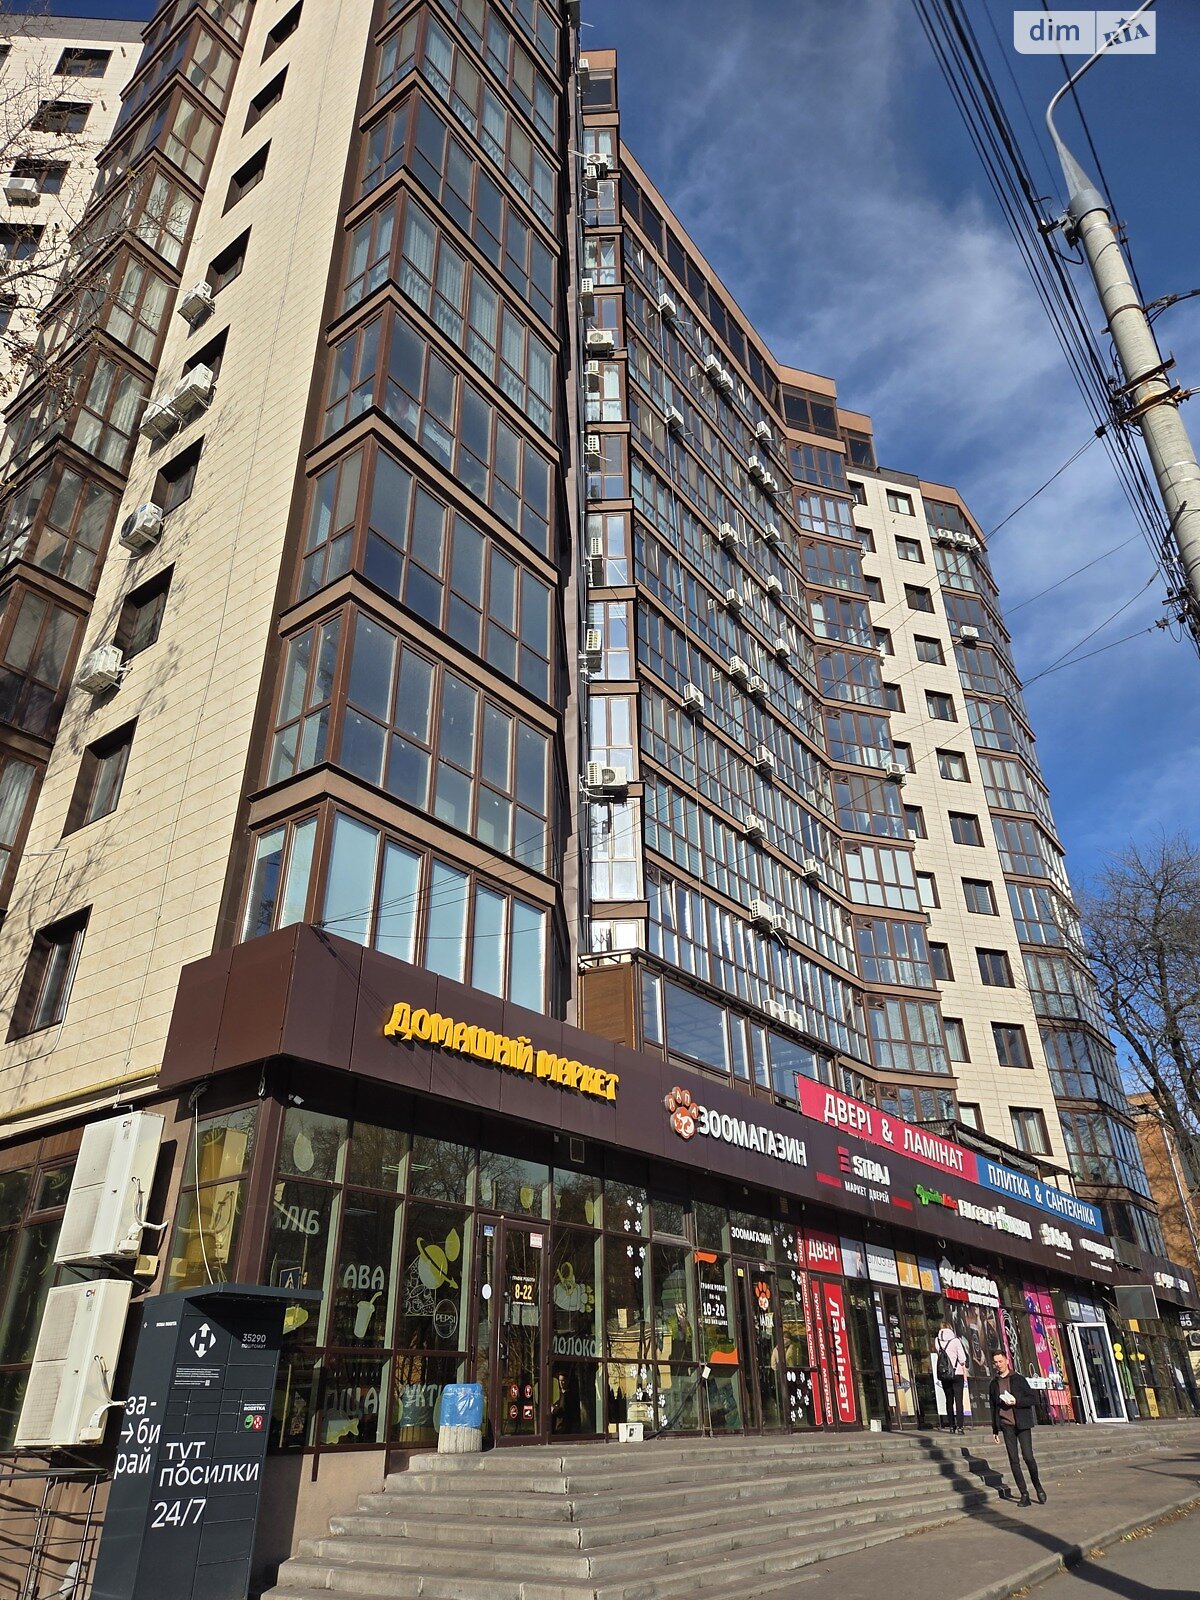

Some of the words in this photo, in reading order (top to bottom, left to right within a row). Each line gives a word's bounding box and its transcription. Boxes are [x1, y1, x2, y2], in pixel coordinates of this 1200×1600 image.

[536, 1050, 620, 1100] МАРКЕТ
[697, 1106, 807, 1167] ЗООМАГАЗИН
[823, 1093, 872, 1134] ДВЕРІ
[881, 1118, 895, 1144] &
[903, 1129, 964, 1172] ЛАМІНАТ
[844, 1180, 867, 1196] МАРКЕТ
[868, 1188, 890, 1204] ДВЕРЕЙ
[987, 1164, 1031, 1199] ПЛИТКА
[1034, 1187, 1044, 1205] &
[1046, 1190, 1097, 1227] САНТЕХНІКА
[731, 1226, 773, 1246] ЗООМАГАЗИН
[808, 1238, 838, 1263] ДВЕРІ
[514, 1283, 533, 1300] 8-22
[435, 1312, 456, 1325] PEPSI
[702, 1302, 726, 1317] 10-20
[242, 1333, 267, 1343] 35290
[113, 1446, 151, 1480] рай
[159, 1462, 260, 1487] посилки
[151, 1498, 206, 1529] 24/7
